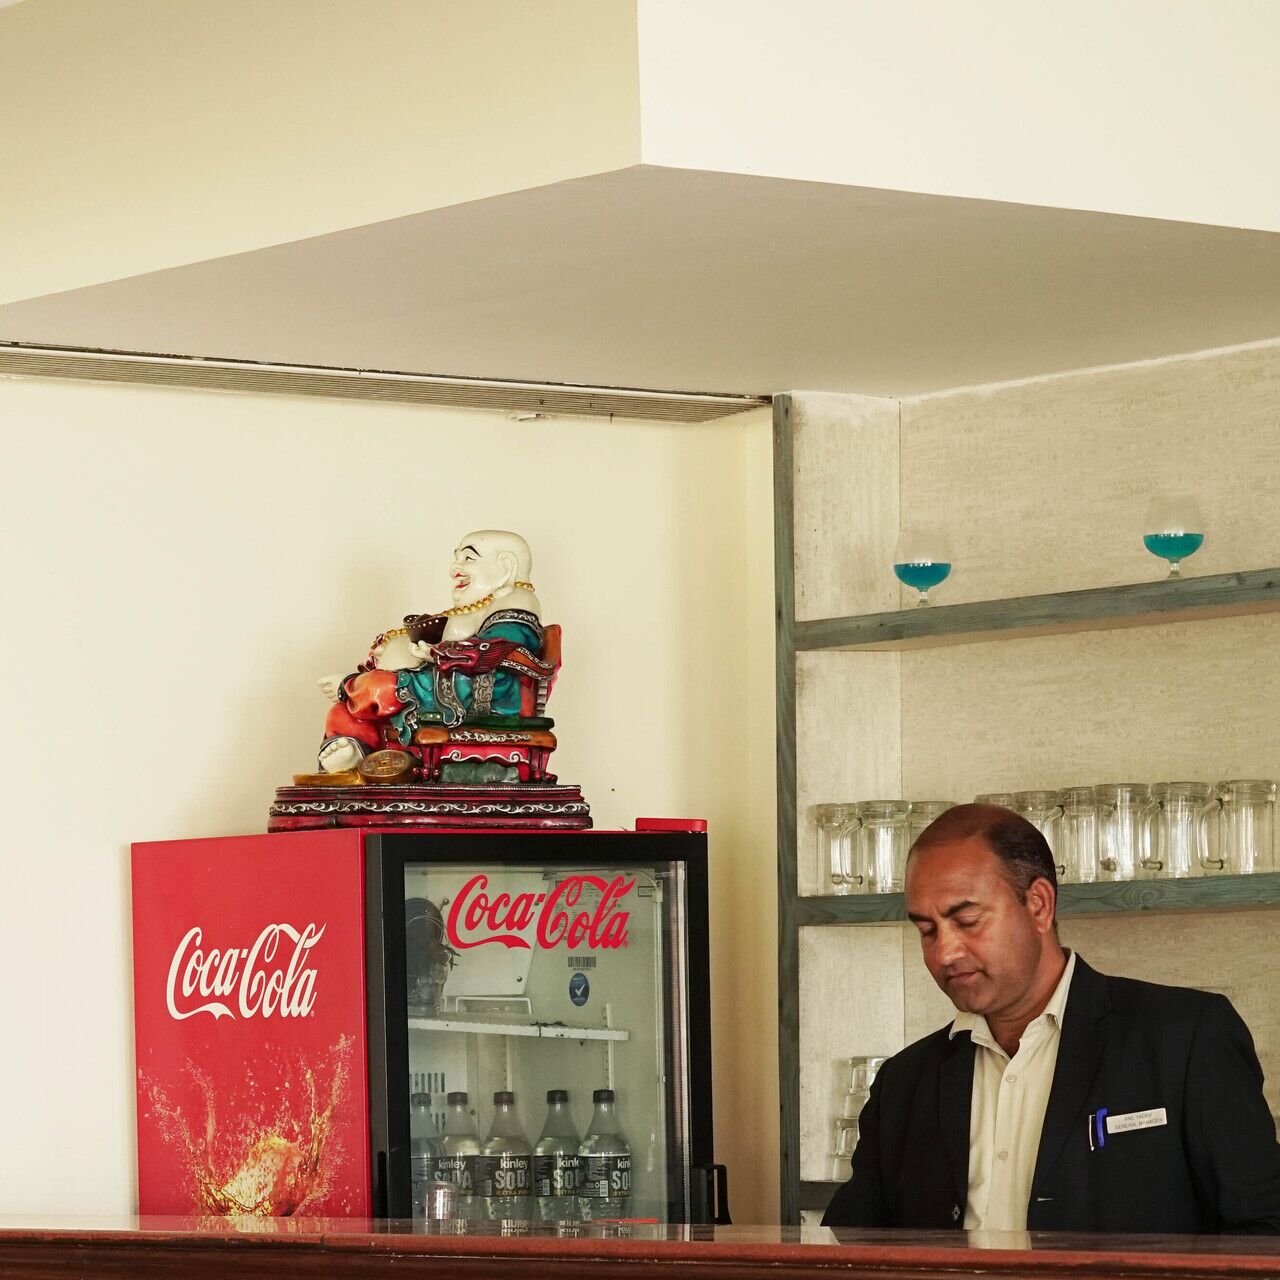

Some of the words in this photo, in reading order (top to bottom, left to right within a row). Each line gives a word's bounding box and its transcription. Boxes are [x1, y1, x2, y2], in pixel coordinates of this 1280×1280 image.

[447, 874, 636, 950] Coca-Cola
[166, 922, 327, 1020] Coca-Cola
[438, 1158, 467, 1171] kinley
[500, 1157, 528, 1170] kinley
[559, 1157, 580, 1169] kinl
[617, 1158, 631, 1169] kin
[494, 1169, 529, 1190] SOD
